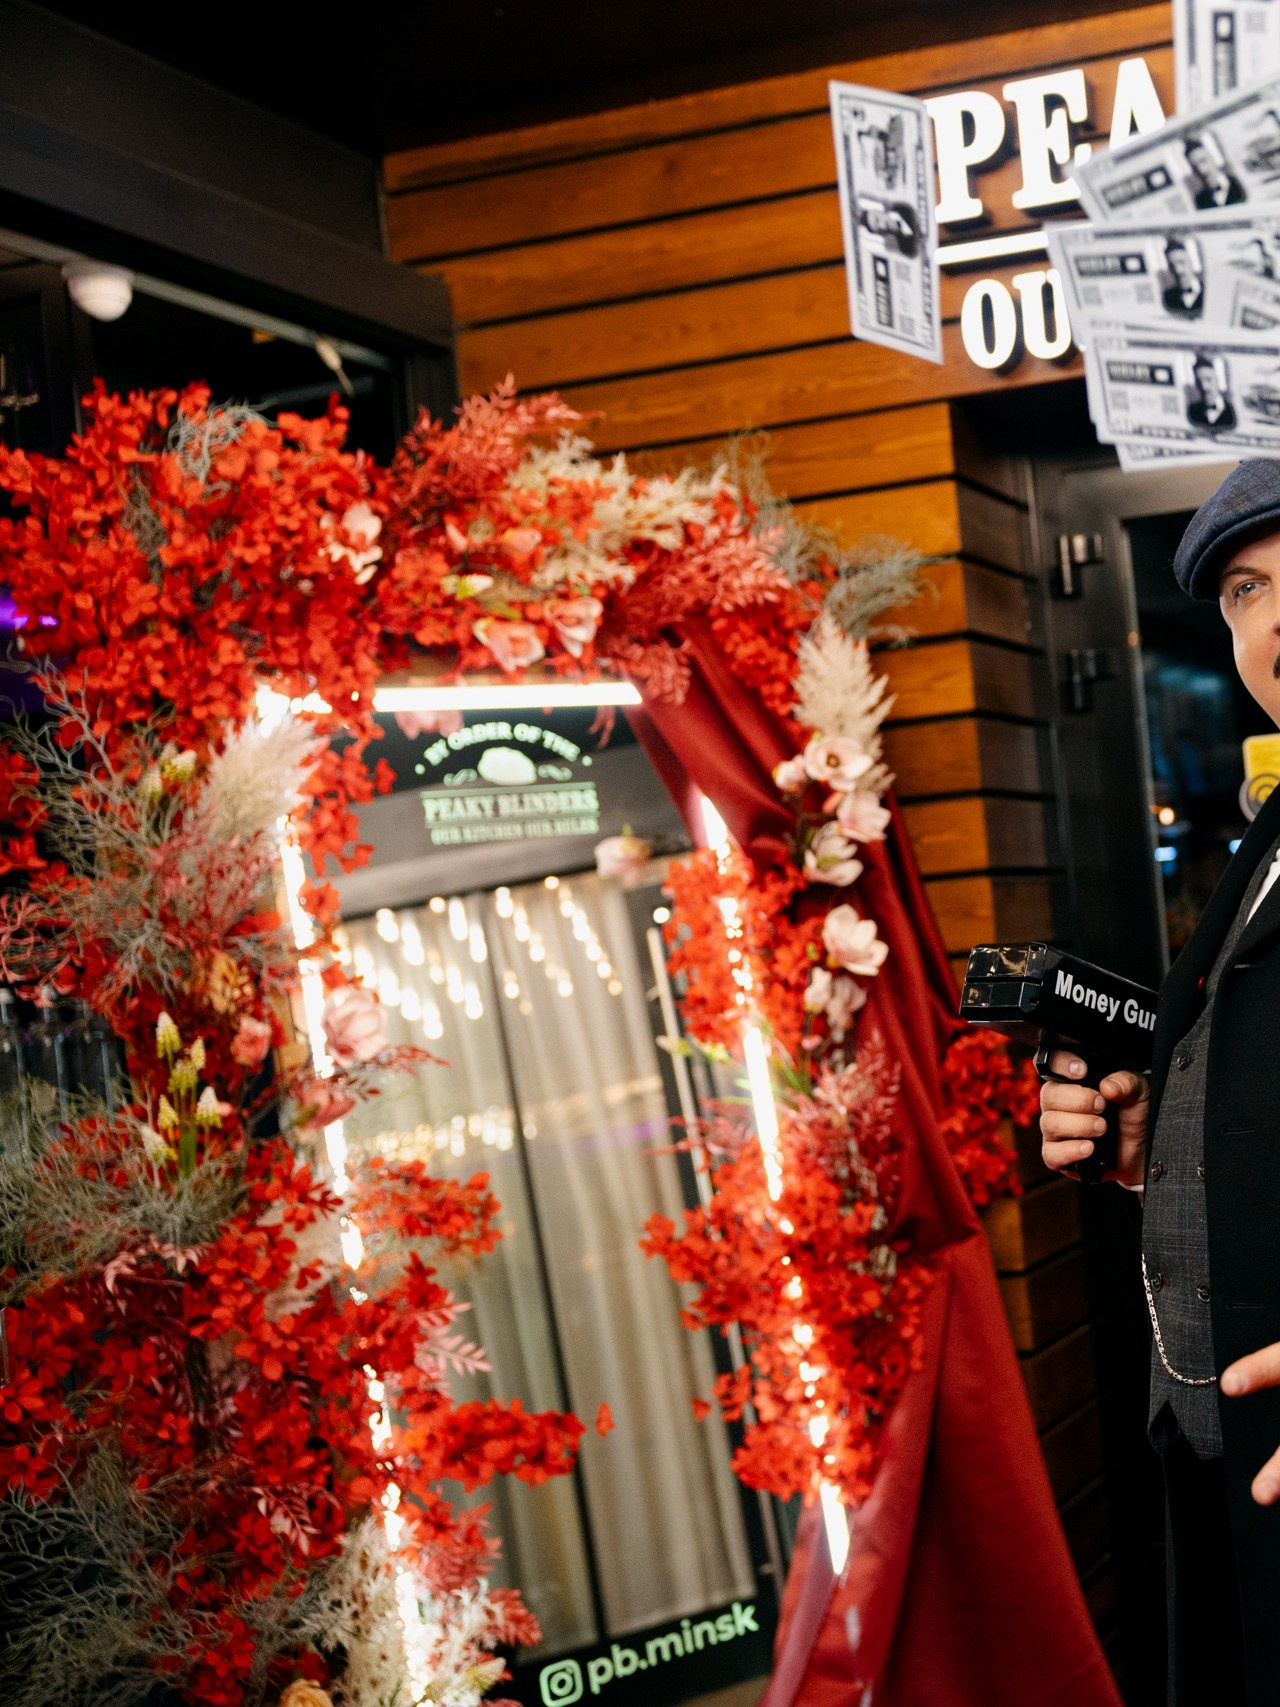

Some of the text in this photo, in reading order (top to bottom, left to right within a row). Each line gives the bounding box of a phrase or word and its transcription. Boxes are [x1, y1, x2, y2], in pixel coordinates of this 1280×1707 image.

[960, 267, 1084, 369] OU
[447, 721, 513, 751] ORDER
[422, 788, 600, 824] PEAKY BLINDERS
[1054, 969, 1121, 1023] Money
[586, 1602, 760, 1695] pb.minsk
